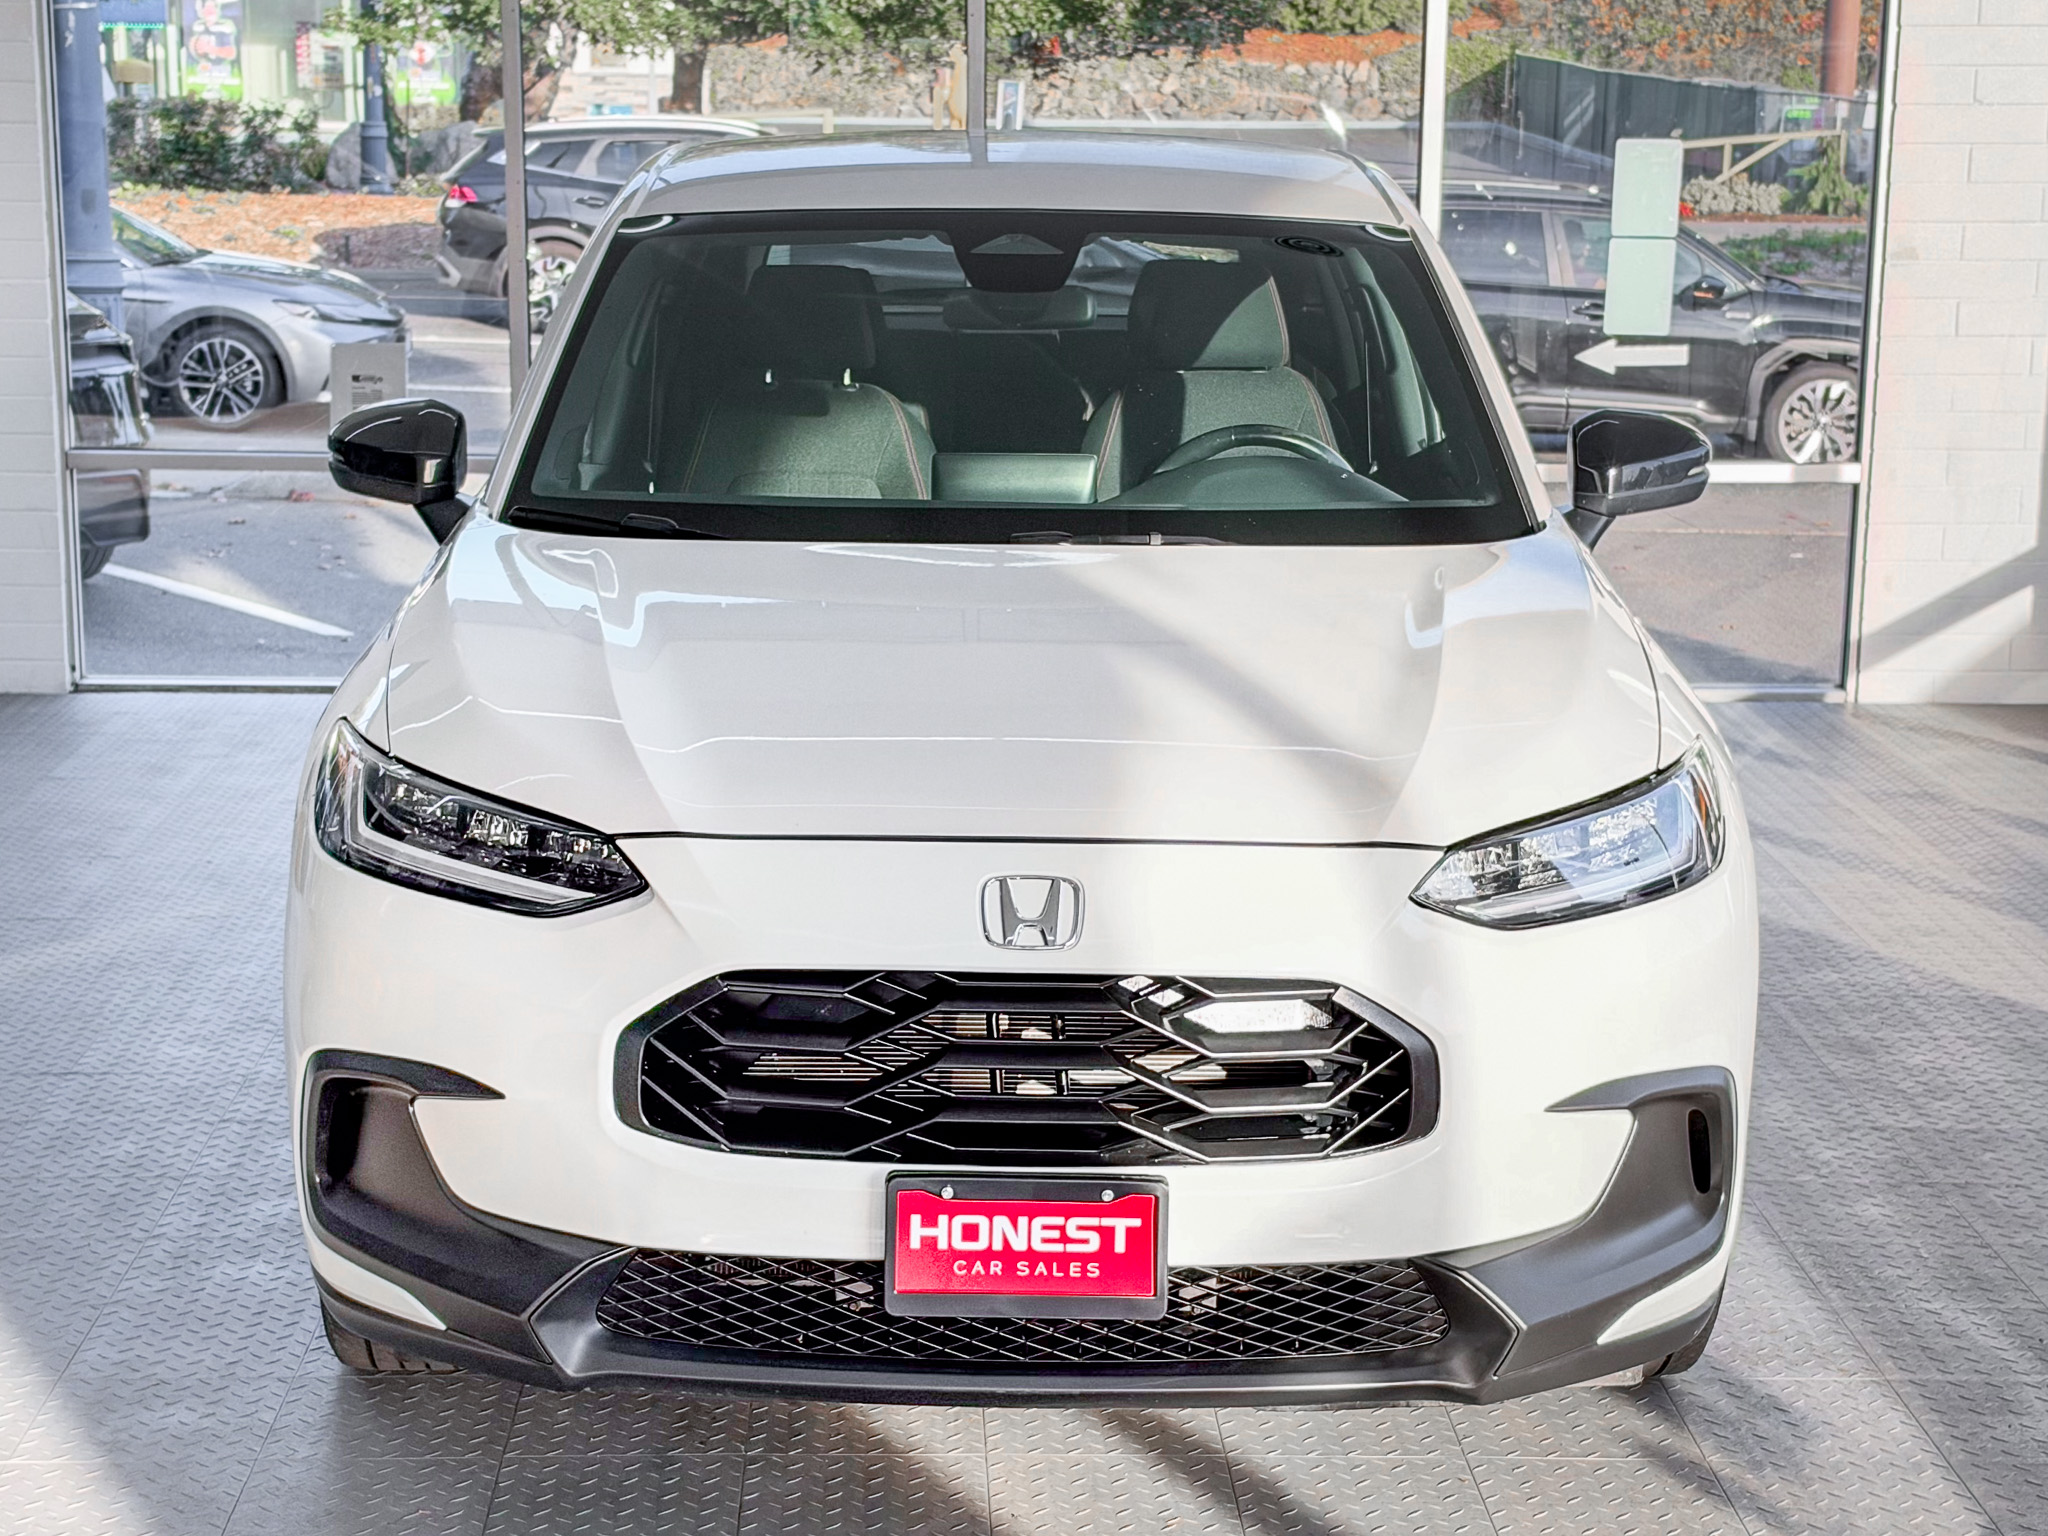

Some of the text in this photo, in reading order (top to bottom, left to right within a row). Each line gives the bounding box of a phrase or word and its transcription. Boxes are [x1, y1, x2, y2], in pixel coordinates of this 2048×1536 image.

[909, 1213, 1142, 1254] HONEST
[952, 1260, 1100, 1278] CAR SALES
